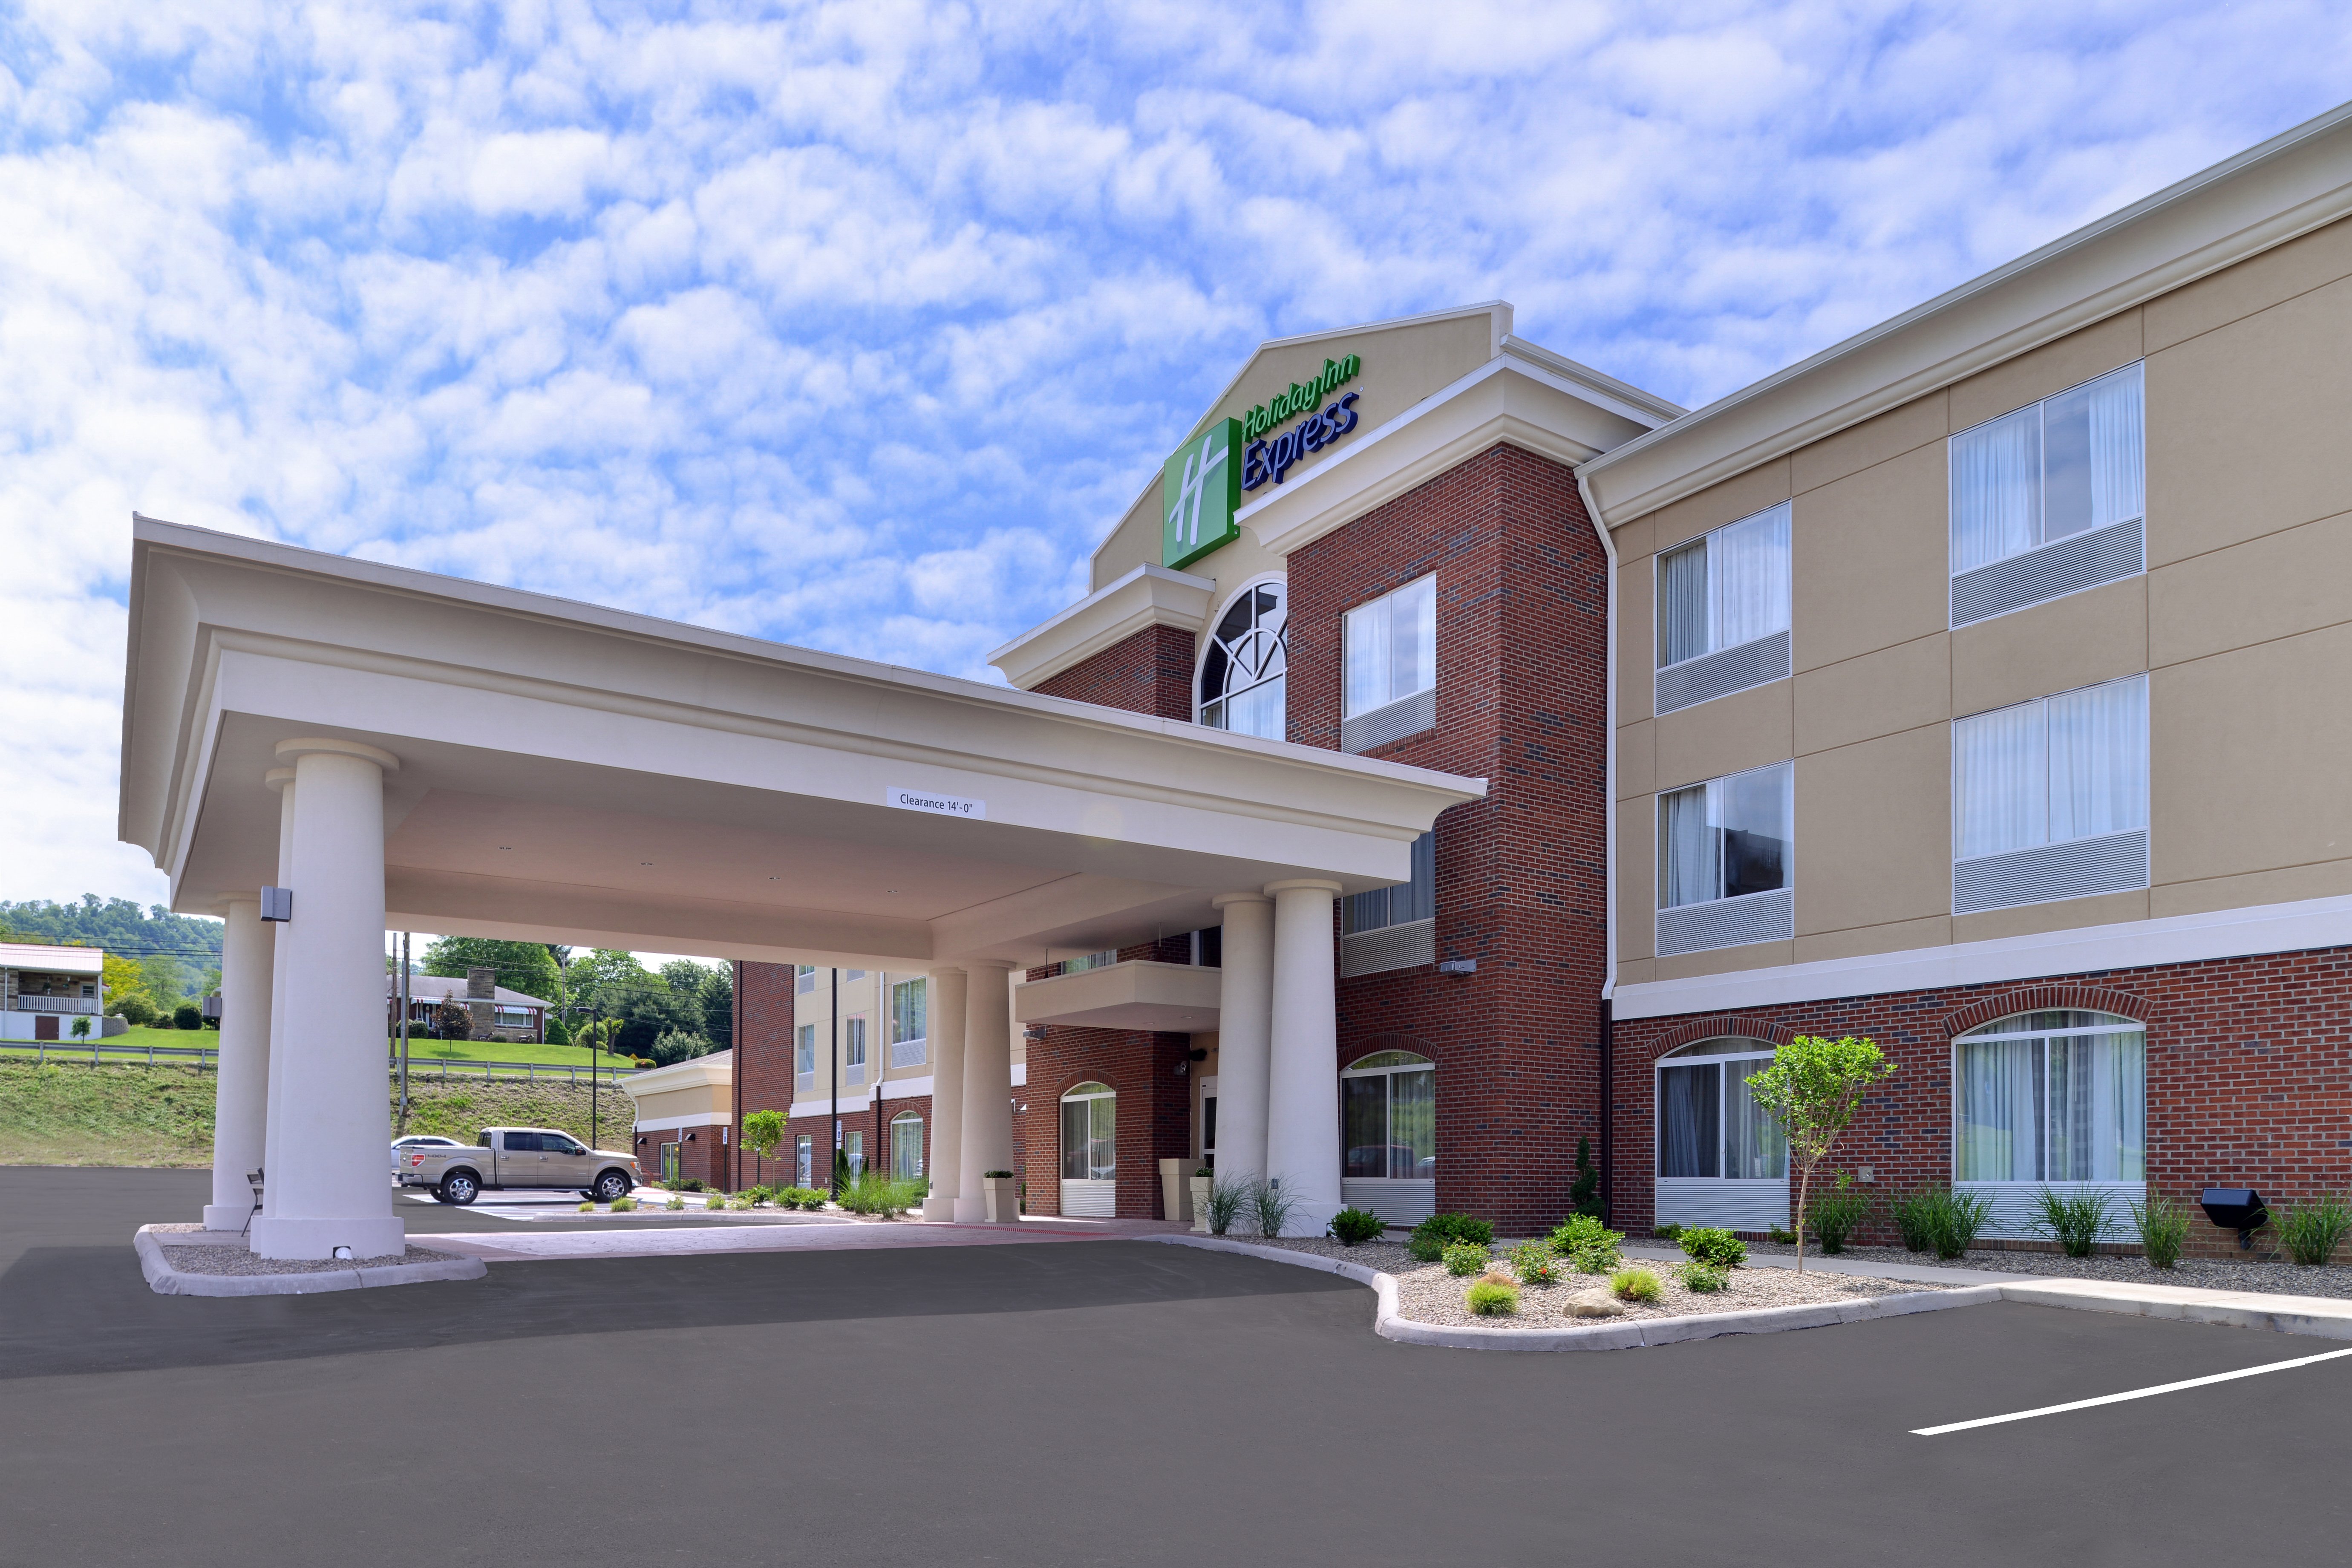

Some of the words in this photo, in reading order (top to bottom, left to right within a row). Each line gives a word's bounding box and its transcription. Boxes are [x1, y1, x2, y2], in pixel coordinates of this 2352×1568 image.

[1241, 392, 1360, 492] Express
[1242, 376, 1321, 443] Holiday
[1320, 353, 1361, 395] Inn
[900, 794, 945, 809] Clearance
